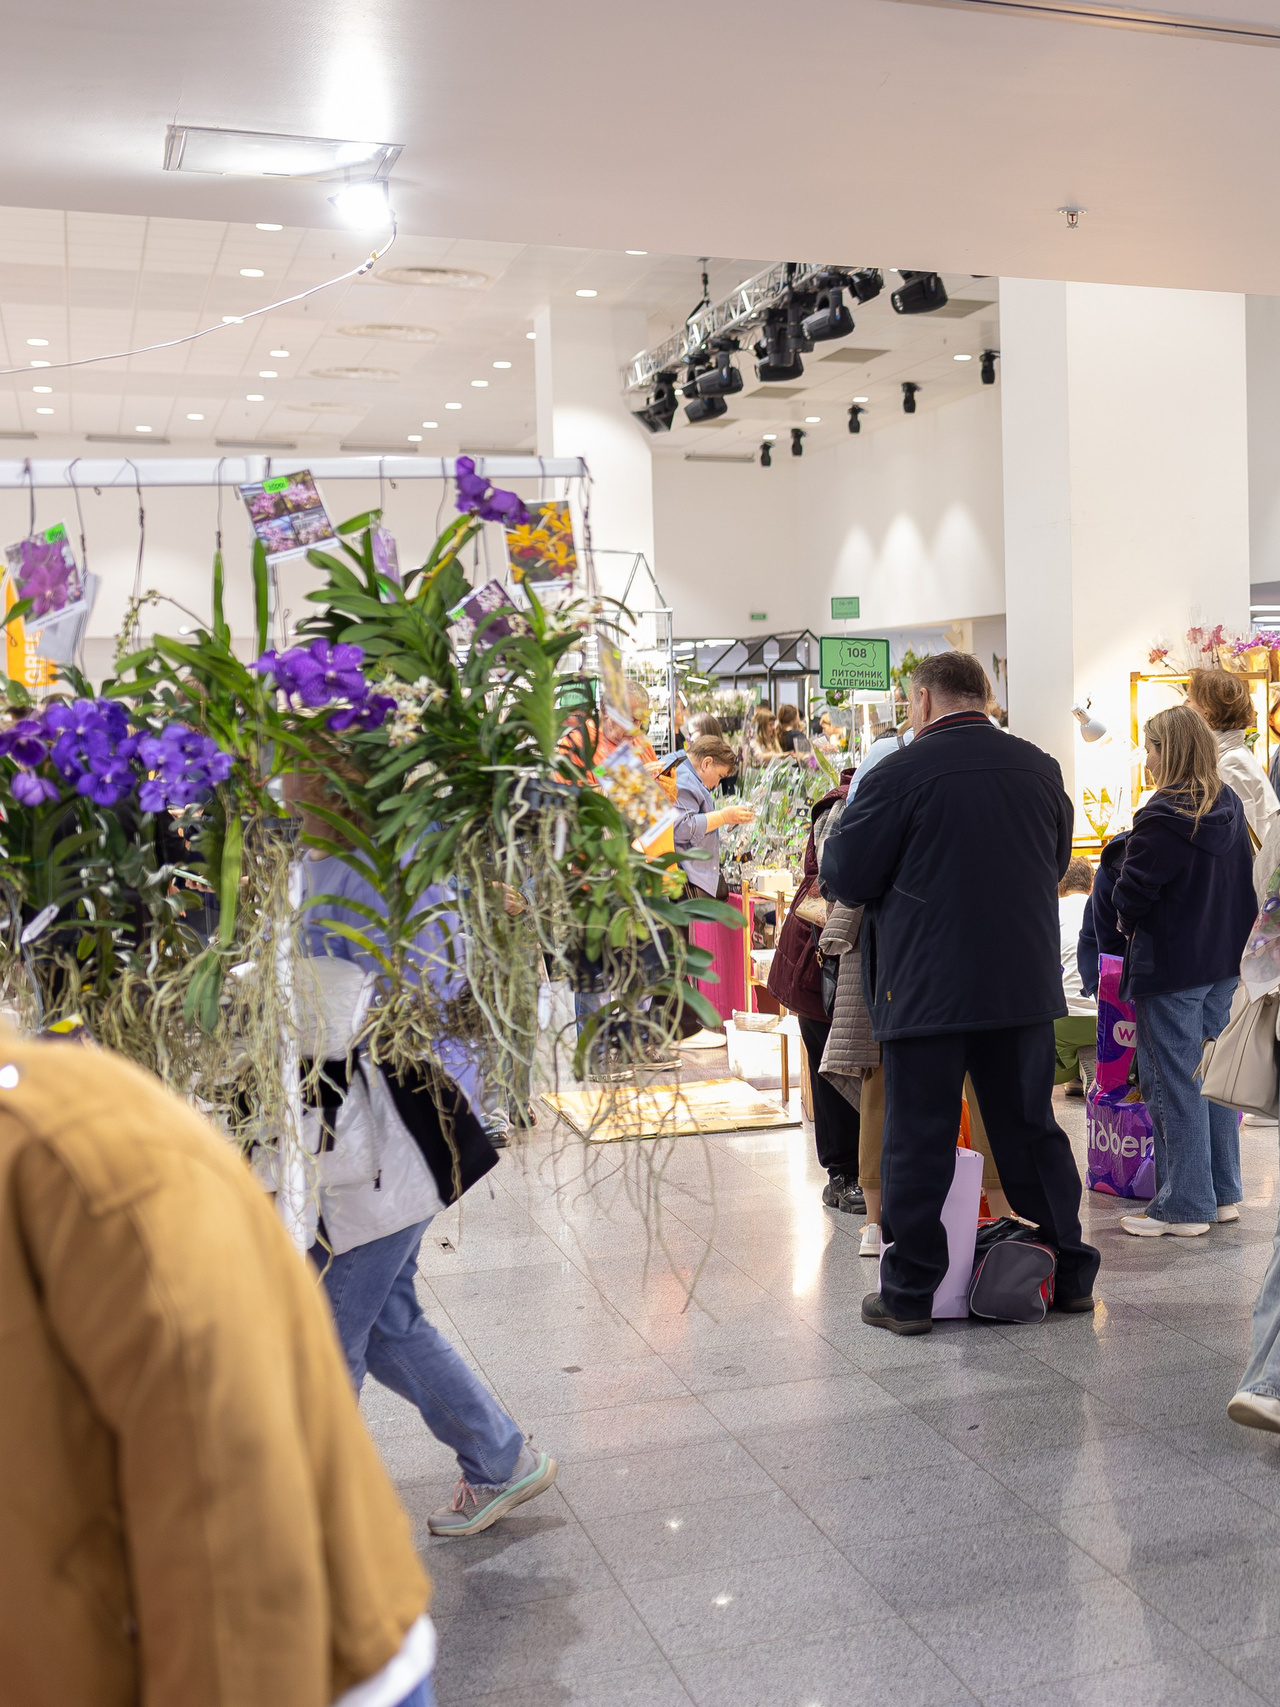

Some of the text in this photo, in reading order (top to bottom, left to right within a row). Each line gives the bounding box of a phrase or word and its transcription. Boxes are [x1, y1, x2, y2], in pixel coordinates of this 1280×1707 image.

[846, 647, 867, 659] 108
[831, 669, 883, 679] ПИТОМНИК
[829, 678, 885, 688] САПЕГИНЫХ
